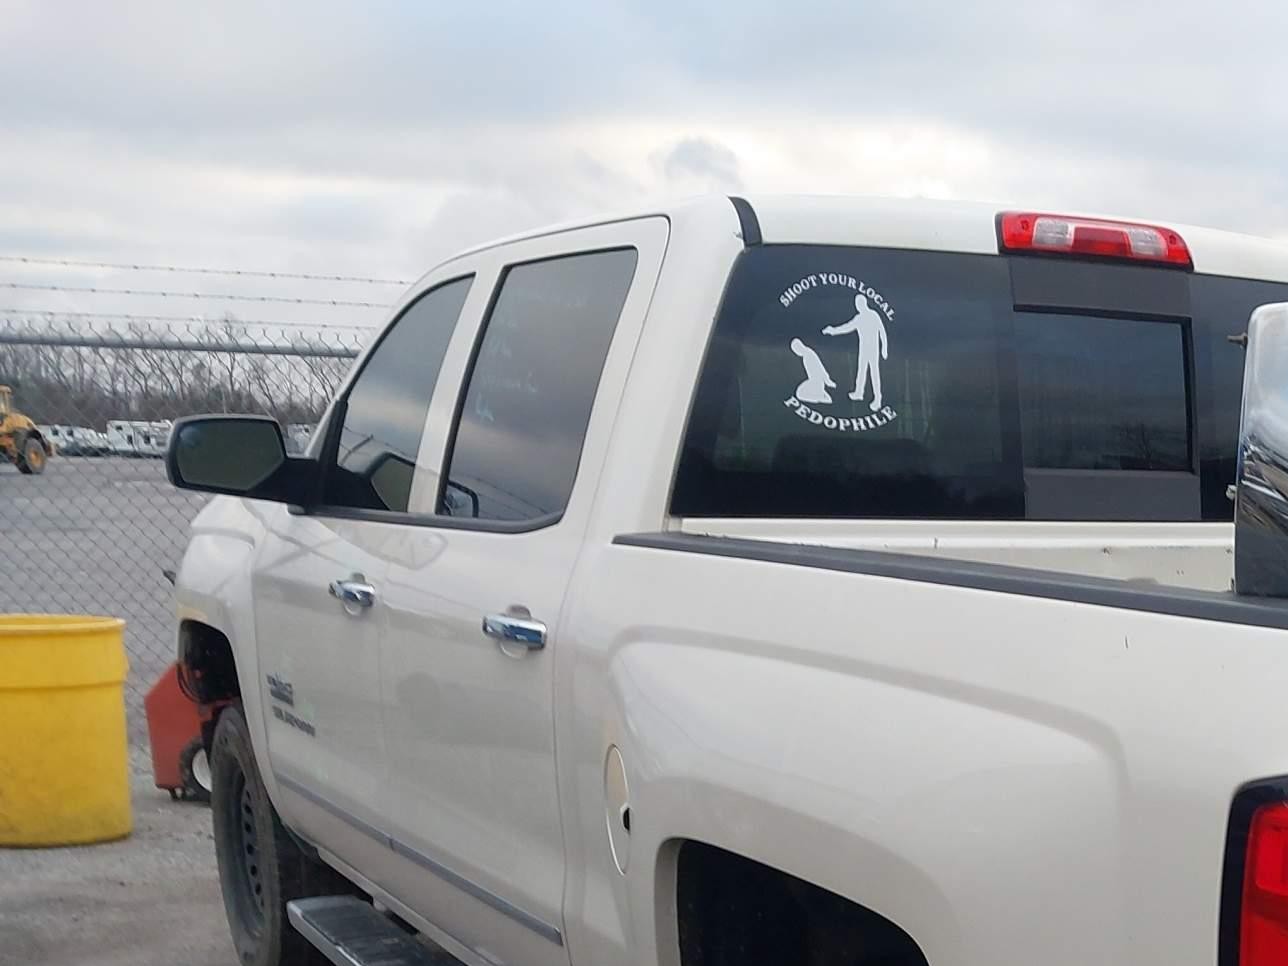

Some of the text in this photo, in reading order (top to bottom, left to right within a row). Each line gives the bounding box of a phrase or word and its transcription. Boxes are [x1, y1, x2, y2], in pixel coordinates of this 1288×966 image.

[779, 272, 894, 321] SHOOT YOUR LOCAL
[783, 395, 897, 431] PEDOPHILE
